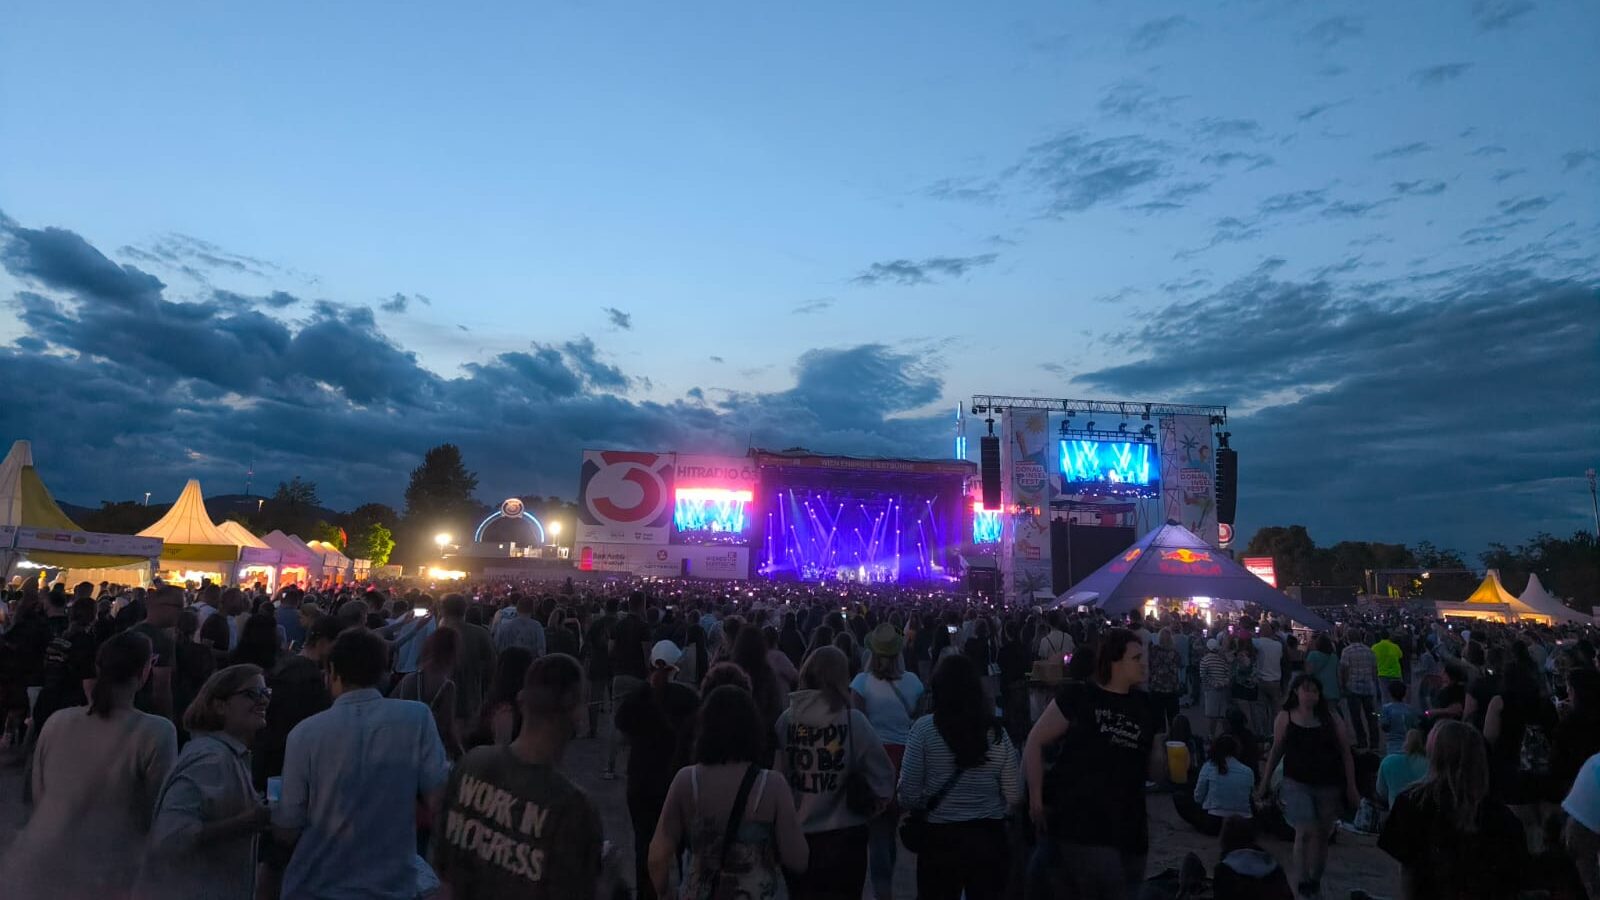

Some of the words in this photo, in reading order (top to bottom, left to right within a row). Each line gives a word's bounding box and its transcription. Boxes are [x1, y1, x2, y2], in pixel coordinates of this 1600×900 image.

[677, 466, 738, 480] HITRADIO
[786, 723, 848, 746] HAPPY
[785, 745, 814, 771] TO
[817, 747, 845, 772] BE
[791, 772, 838, 794] ALIVE
[458, 773, 519, 829] WORK
[519, 801, 550, 839] IN
[445, 809, 545, 882] PROGRESS
